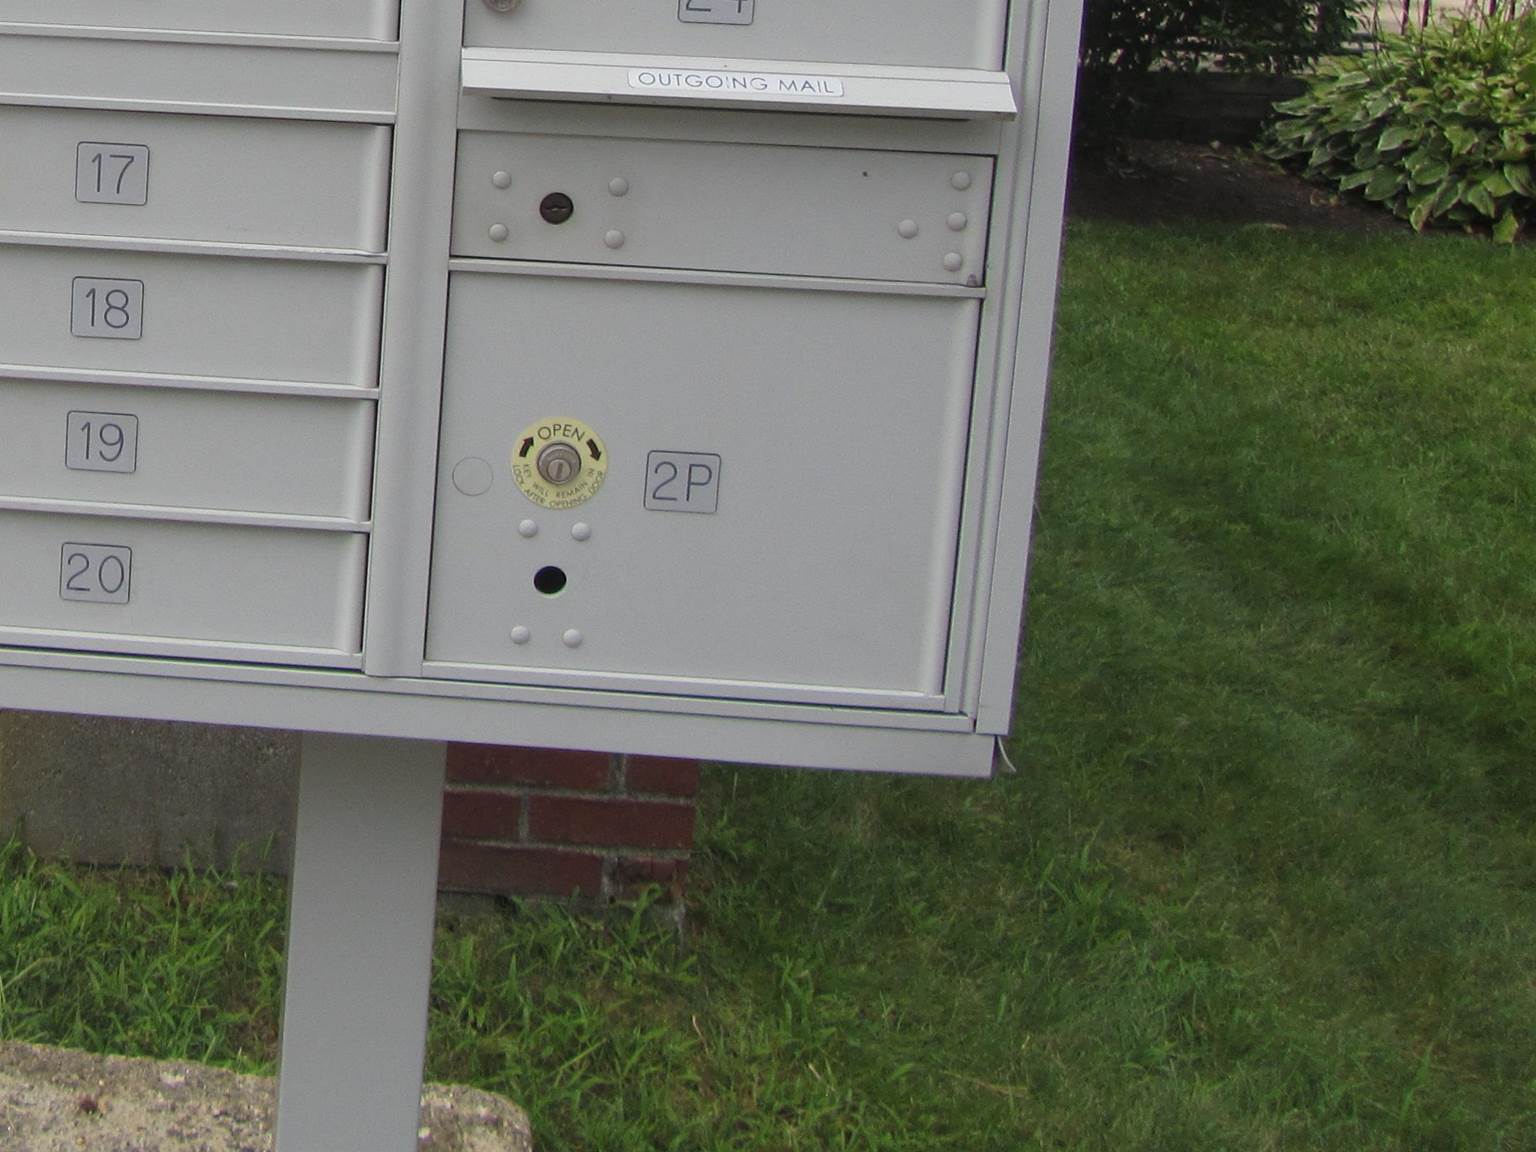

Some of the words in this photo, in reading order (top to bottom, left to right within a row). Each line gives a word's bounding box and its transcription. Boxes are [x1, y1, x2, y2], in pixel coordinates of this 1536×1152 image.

[638, 71, 768, 91] OUTGOING
[779, 79, 834, 93] MAIL
[91, 154, 134, 194] 17
[85, 288, 129, 328] 18
[80, 422, 123, 460] 19
[537, 423, 586, 441] OPEN
[653, 463, 713, 501] 2P
[67, 553, 125, 593] 20
